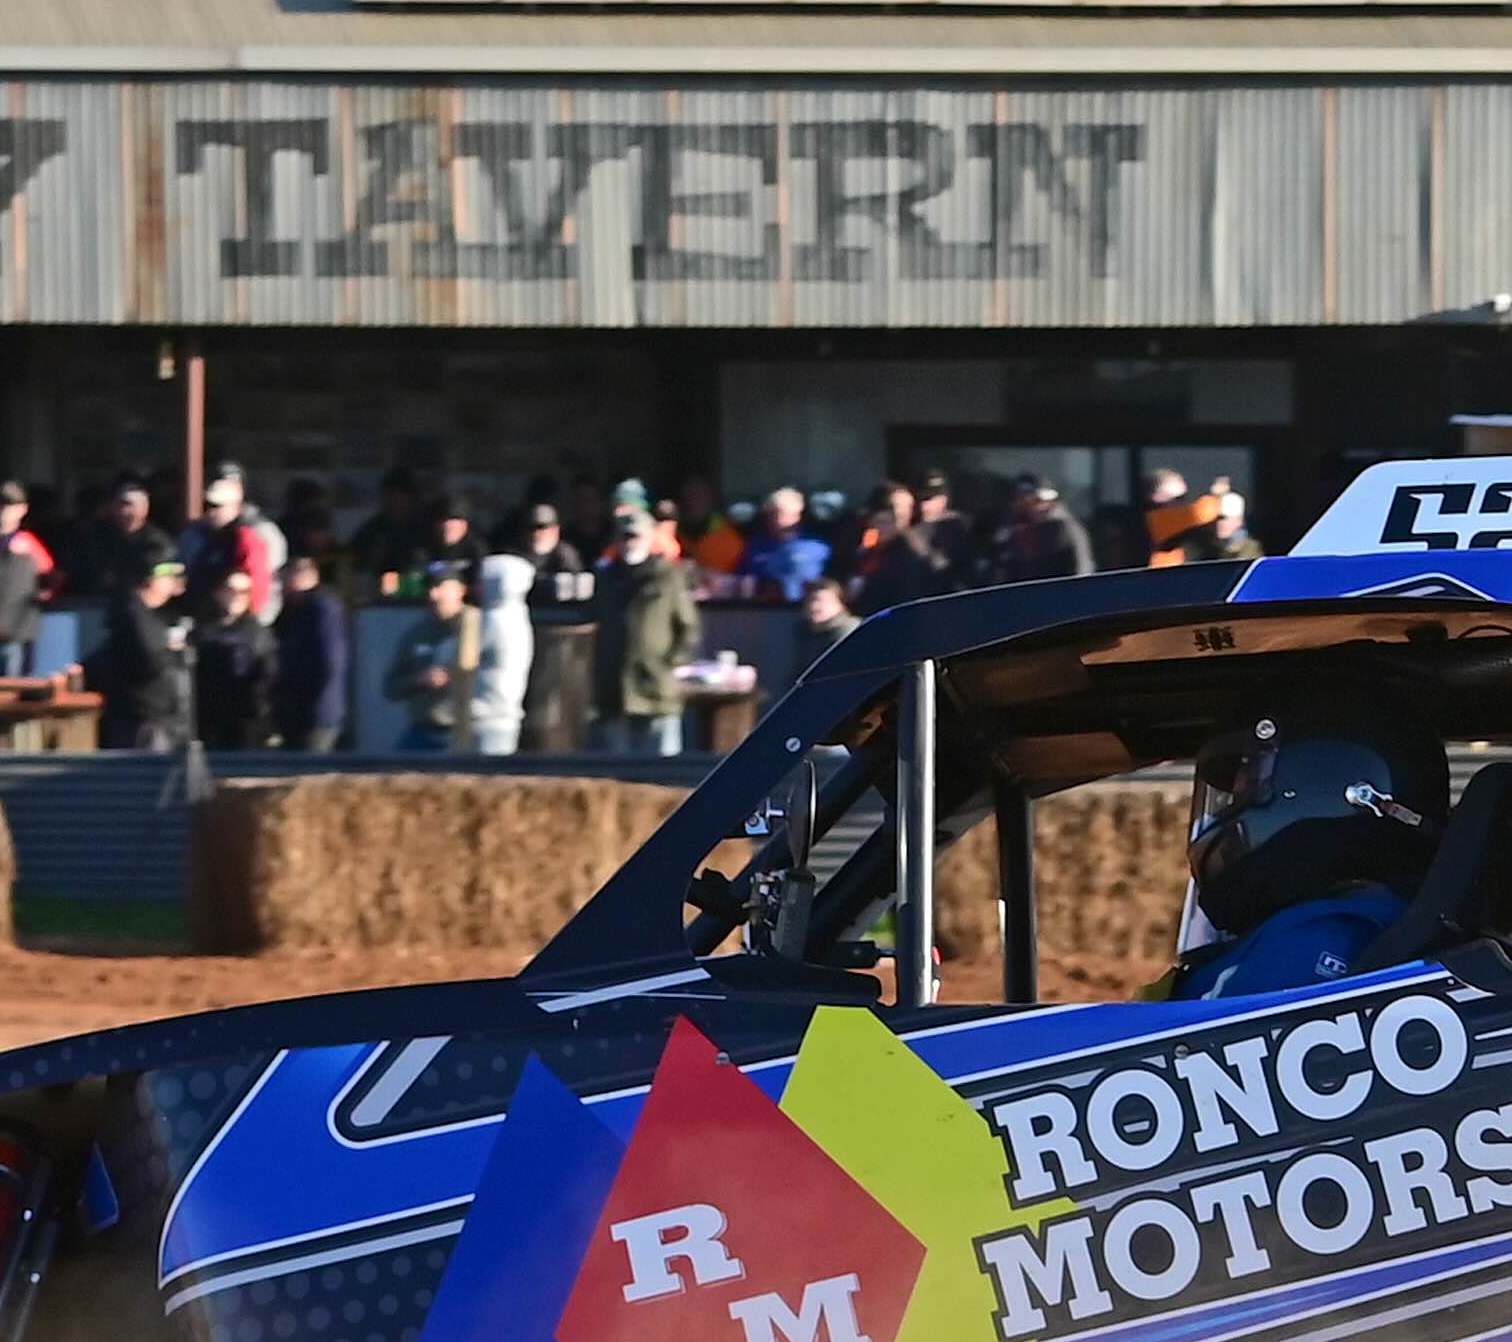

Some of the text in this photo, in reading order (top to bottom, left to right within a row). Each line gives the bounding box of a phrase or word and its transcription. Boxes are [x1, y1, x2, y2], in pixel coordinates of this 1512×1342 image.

[175, 117, 1146, 283] TAVERN
[994, 995, 1468, 1201] RONCO
[609, 1203, 746, 1304] R
